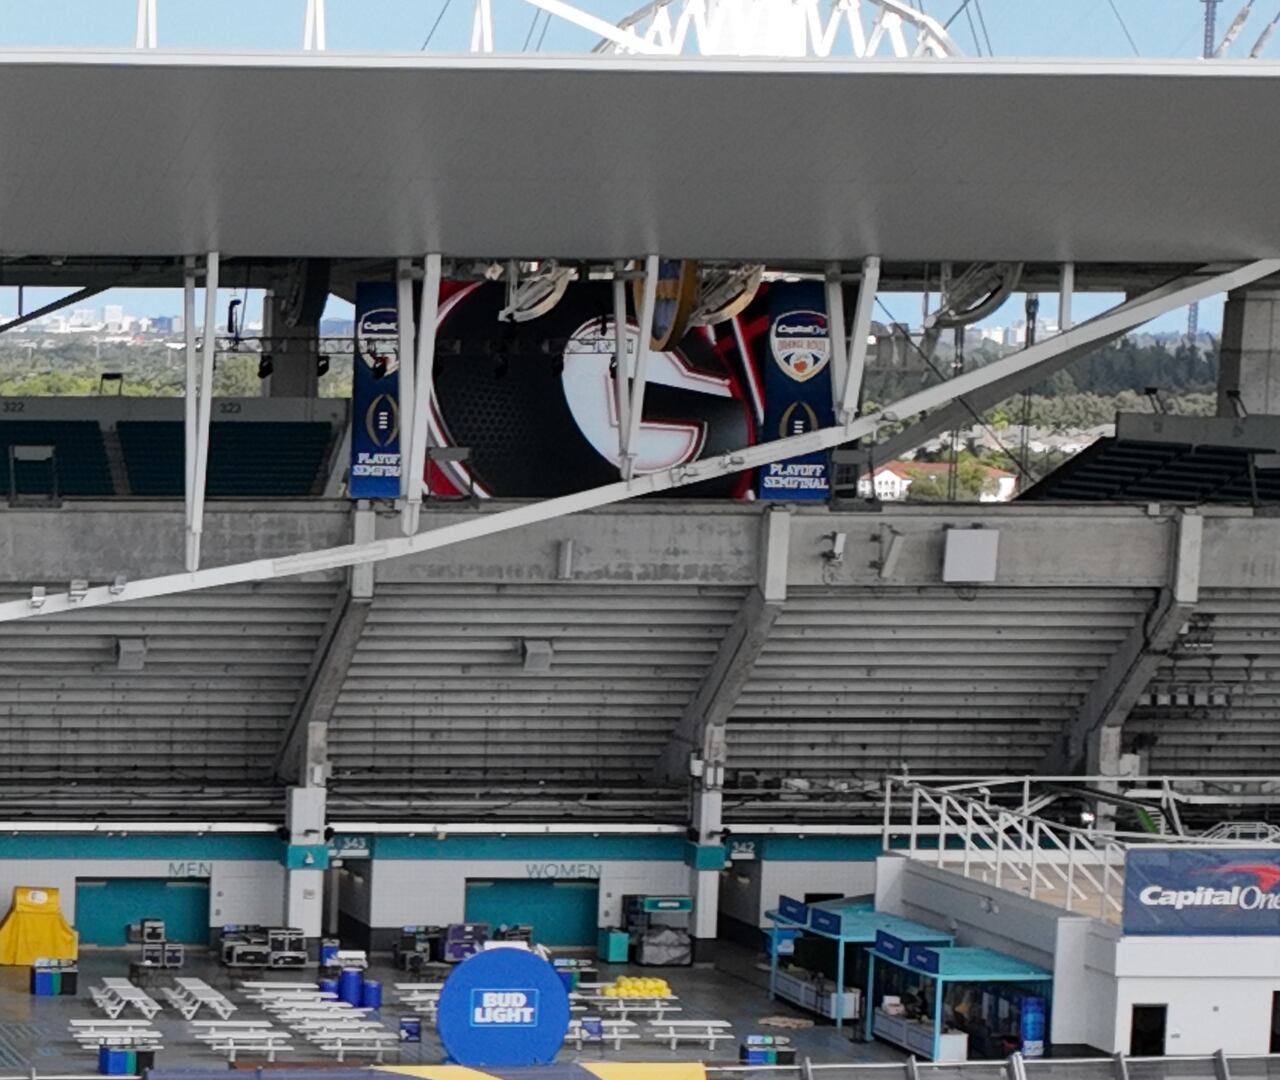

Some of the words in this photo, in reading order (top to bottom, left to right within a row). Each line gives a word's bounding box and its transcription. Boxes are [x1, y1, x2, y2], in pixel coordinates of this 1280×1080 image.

[770, 463, 825, 476] PLAYOFF
[763, 476, 829, 489] SEMIFINAL
[731, 842, 756, 853] 342
[167, 862, 213, 876] MEN
[525, 864, 603, 878] WOMEN
[482, 991, 527, 1008] BUD
[474, 1006, 535, 1024] LIGHT
